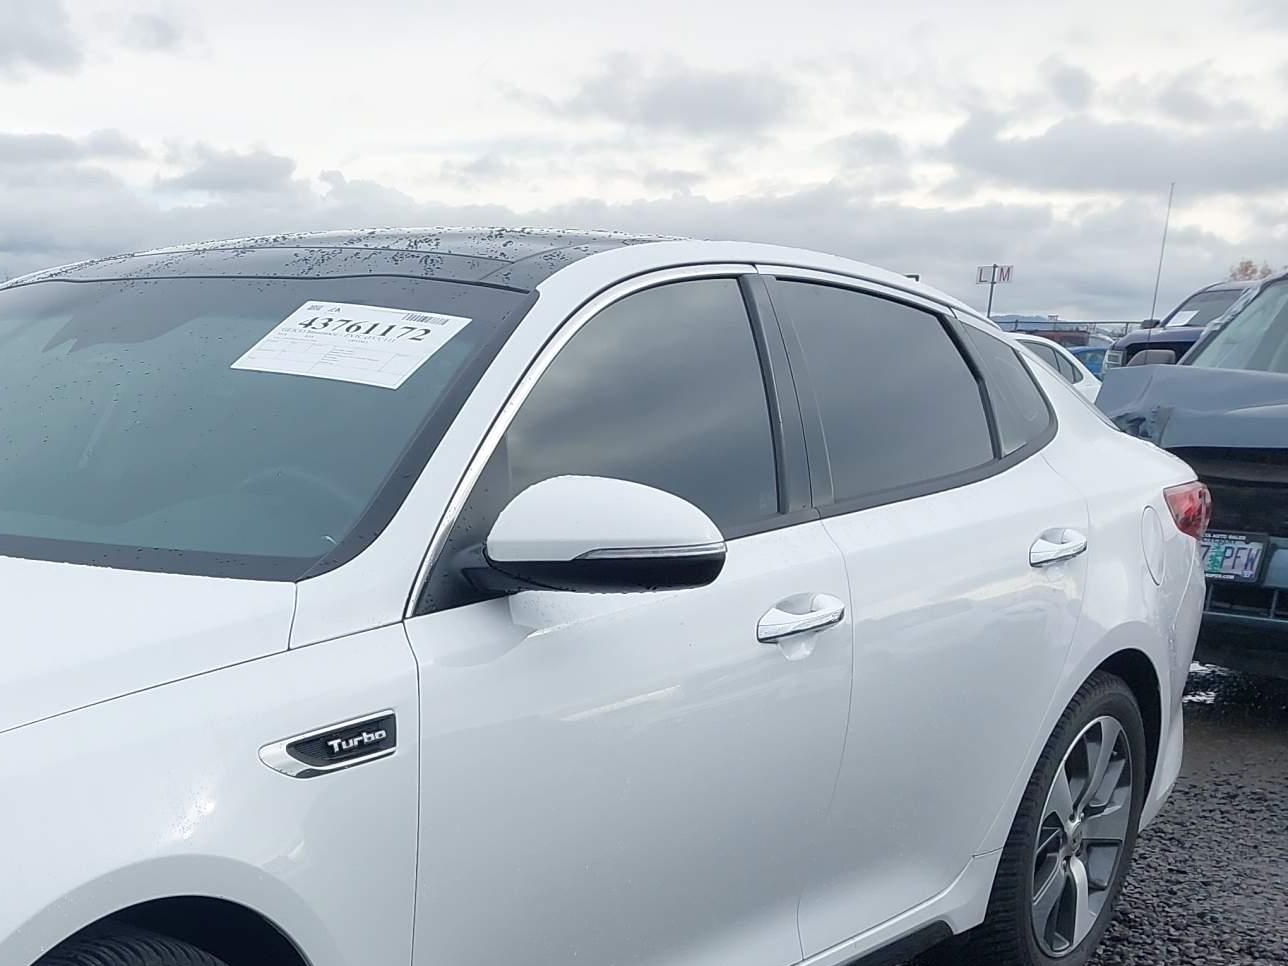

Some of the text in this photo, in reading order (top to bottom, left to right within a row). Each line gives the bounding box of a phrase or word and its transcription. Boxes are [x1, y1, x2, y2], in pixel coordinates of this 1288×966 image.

[979, 267, 1011, 283] L M
[298, 316, 432, 342] 43761172
[328, 729, 387, 753] Turbo
